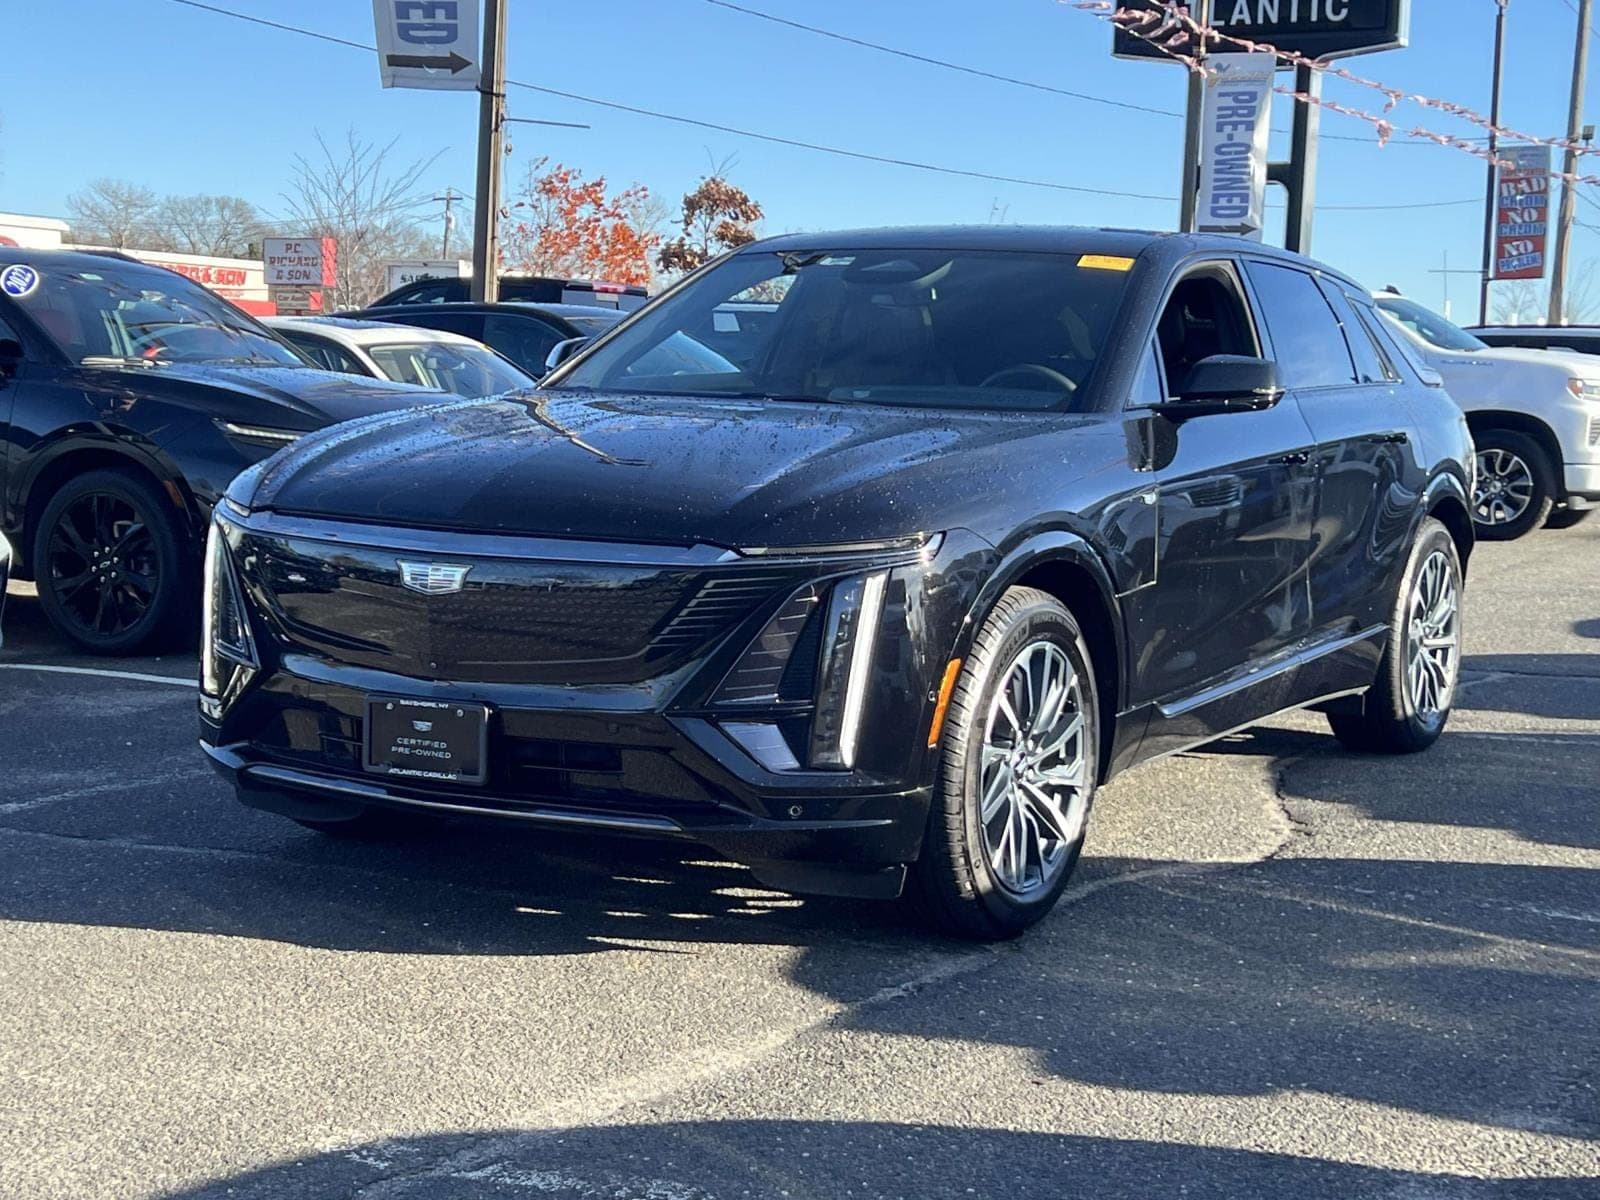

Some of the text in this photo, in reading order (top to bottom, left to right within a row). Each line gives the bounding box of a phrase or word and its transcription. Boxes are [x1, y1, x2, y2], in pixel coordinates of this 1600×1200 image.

[1210, 91, 1258, 219] PRE-OWNED
[1507, 207, 1538, 224] NO
[1503, 239, 1534, 257] NO
[215, 269, 247, 287] SON
[287, 269, 311, 280] SON
[396, 737, 448, 749] CERTIFIED
[391, 746, 452, 759] PRE-OWNED
